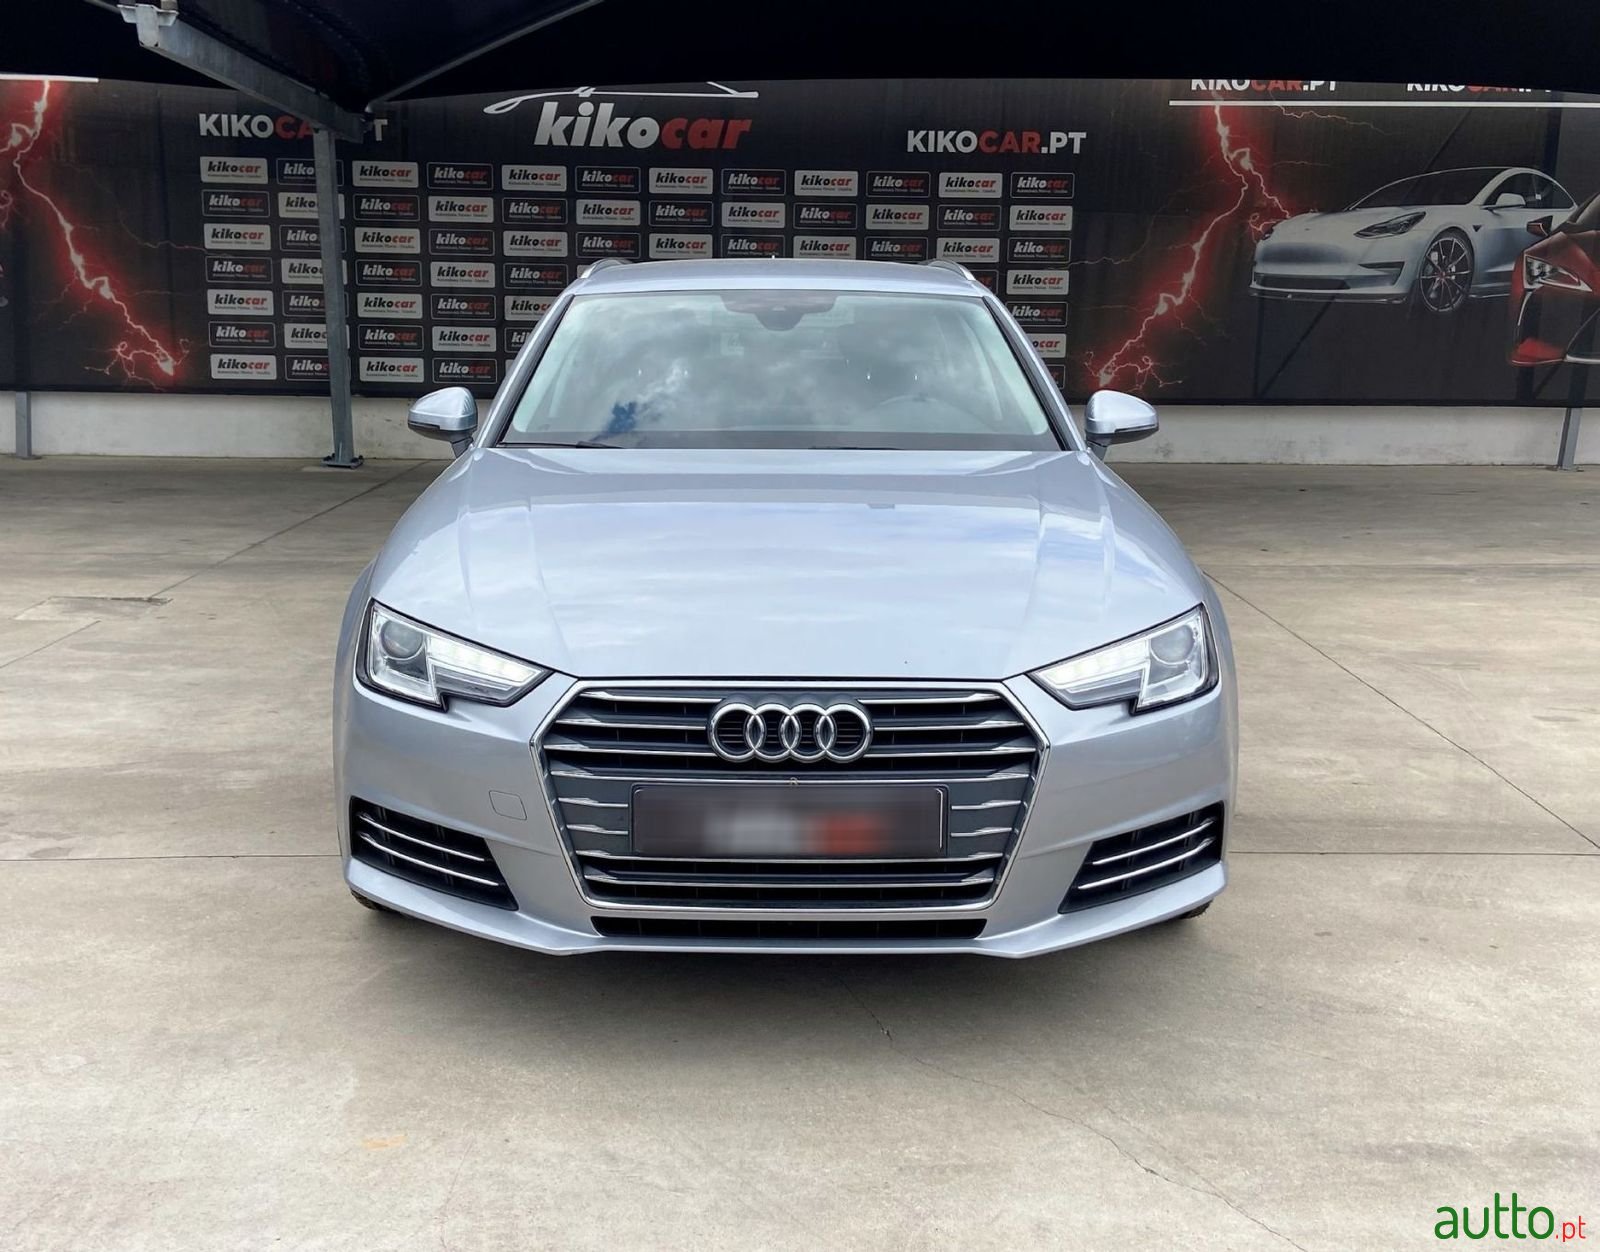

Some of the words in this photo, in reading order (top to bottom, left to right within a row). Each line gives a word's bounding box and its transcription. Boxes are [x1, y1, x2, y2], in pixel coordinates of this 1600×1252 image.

[534, 101, 752, 149] kikocar
[907, 130, 1087, 154] KIKOCAR.PT
[208, 161, 261, 174] kikocar
[284, 163, 315, 175] kiko
[360, 165, 412, 178] kikocar
[435, 167, 487, 179] kikocar
[509, 169, 561, 181] kikocar
[583, 171, 634, 183] kikocar
[656, 172, 707, 184] kikocar
[729, 174, 780, 185] kikocar
[801, 175, 852, 186] kikocar
[873, 176, 924, 187] kikocar
[945, 177, 996, 188] kikocar
[1017, 177, 1068, 189] kikocar
[209, 195, 263, 207] kikocar
[285, 197, 318, 208] kiko
[361, 199, 413, 211] kikocar
[435, 201, 487, 213] kikocar
[509, 202, 561, 214] kikocar
[583, 204, 634, 216] kikocar
[656, 206, 707, 217] kikocar
[728, 207, 779, 218] kikocar
[801, 208, 851, 219] kikocar
[873, 209, 923, 220] kikocar
[944, 210, 995, 221] kikocar
[1016, 210, 1066, 221] kikocar
[211, 229, 264, 240] kikocar
[287, 230, 318, 241] kiko
[362, 232, 414, 244] kikocar
[436, 234, 488, 245] kikocar
[510, 235, 561, 247] kikocar
[583, 237, 634, 248] kikocar
[656, 238, 706, 249] kikocar
[728, 240, 779, 250] kikocar
[800, 241, 850, 251] kikocar
[872, 241, 922, 252] kikocar
[943, 242, 993, 253] kikocar
[1015, 242, 1065, 253] kikocar
[213, 262, 265, 274] kikocar
[363, 265, 415, 277] kikocar
[437, 267, 488, 278] kikocar
[510, 268, 562, 279] kikocar
[1013, 274, 1063, 285] kikocar
[214, 294, 267, 306] kikocar
[364, 297, 416, 309] kikocar
[438, 299, 489, 310] kikocar
[511, 300, 551, 311] kikoc
[1012, 306, 1062, 317] kikocar
[216, 327, 269, 339] kikocar
[291, 328, 328, 339] kikoc
[365, 329, 417, 341] kikocar
[439, 331, 490, 342] kikocar
[218, 359, 270, 371] kikocar
[292, 360, 331, 371] kikoc
[366, 361, 418, 373] kikocar
[439, 362, 491, 374] kikocar
